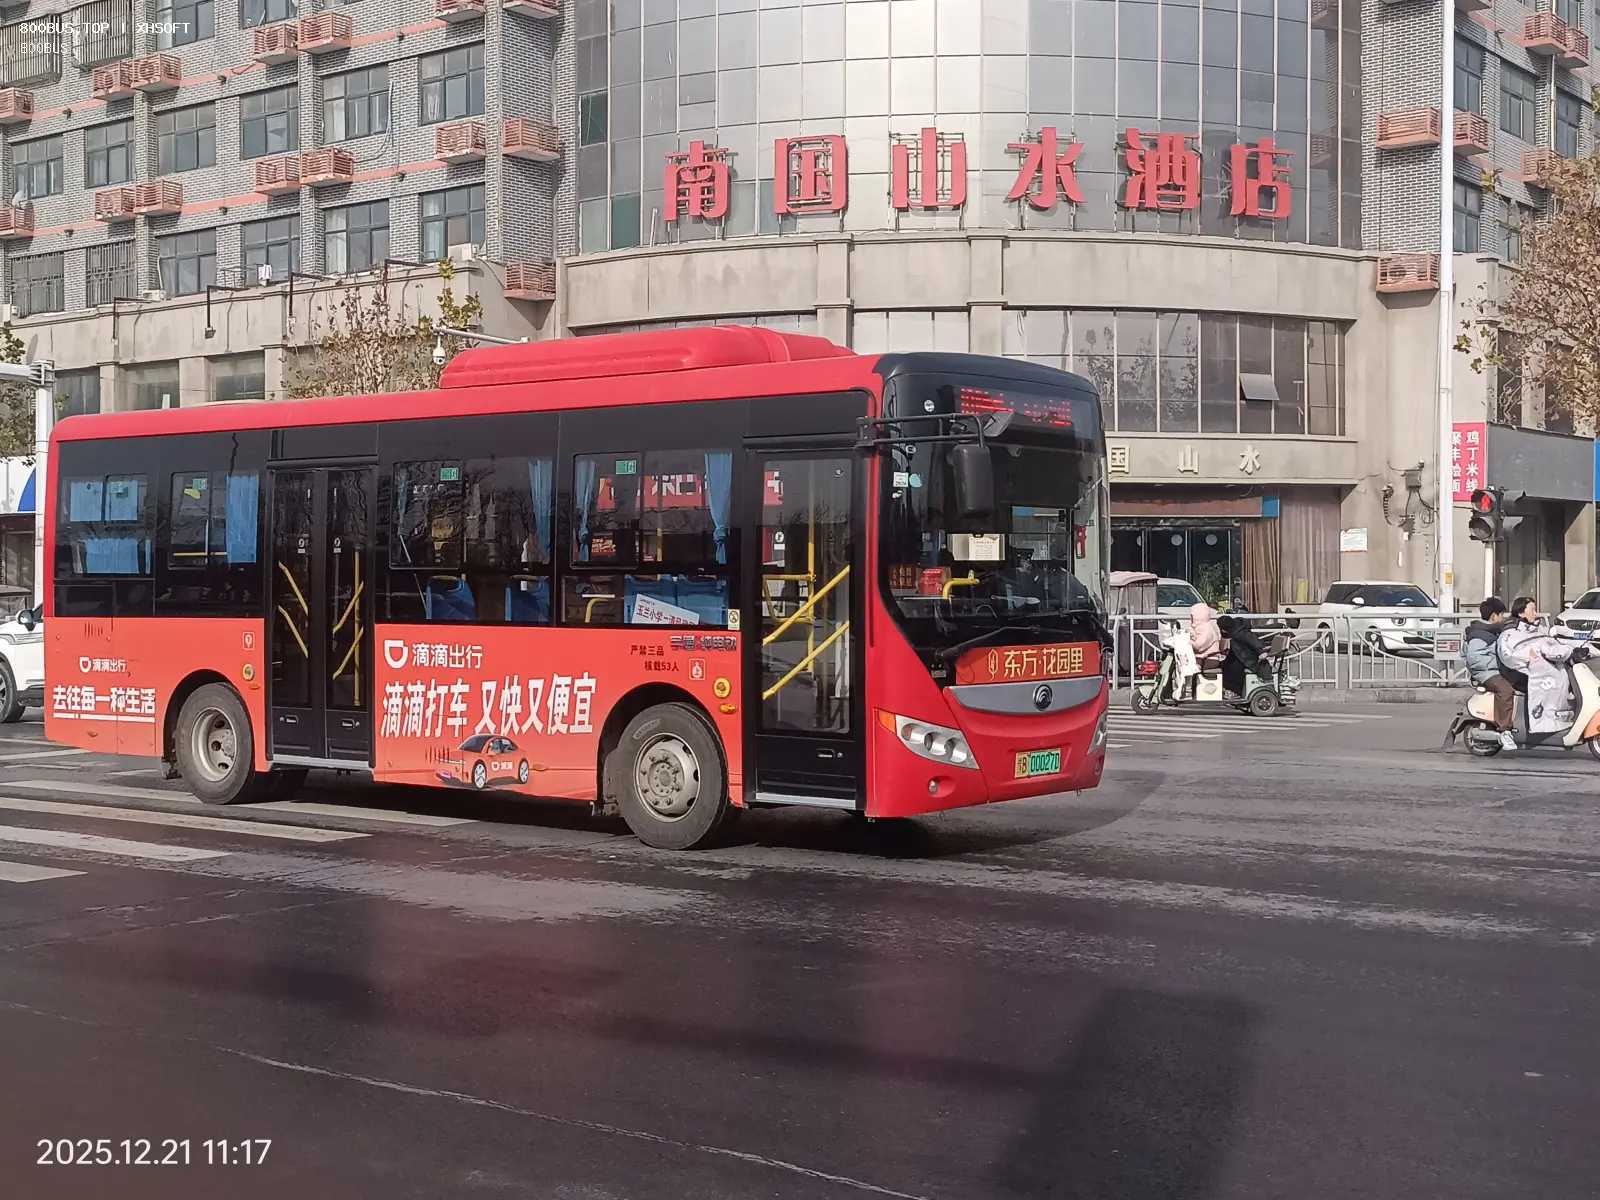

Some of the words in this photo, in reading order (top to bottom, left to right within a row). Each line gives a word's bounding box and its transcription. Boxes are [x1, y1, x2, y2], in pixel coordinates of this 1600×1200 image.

[664, 126, 1295, 221] 南国山水酒店
[1108, 444, 1261, 475] 国山水
[1465, 430, 1480, 493] 鸡丁米线
[92, 658, 127, 673] 滴滴出行
[412, 642, 483, 669] 滴滴出行
[630, 644, 665, 657] 严禁三品
[53, 685, 156, 714] 去往每一种生活
[380, 677, 470, 739] 滴滴打车
[474, 671, 597, 737] 又快又便宜
